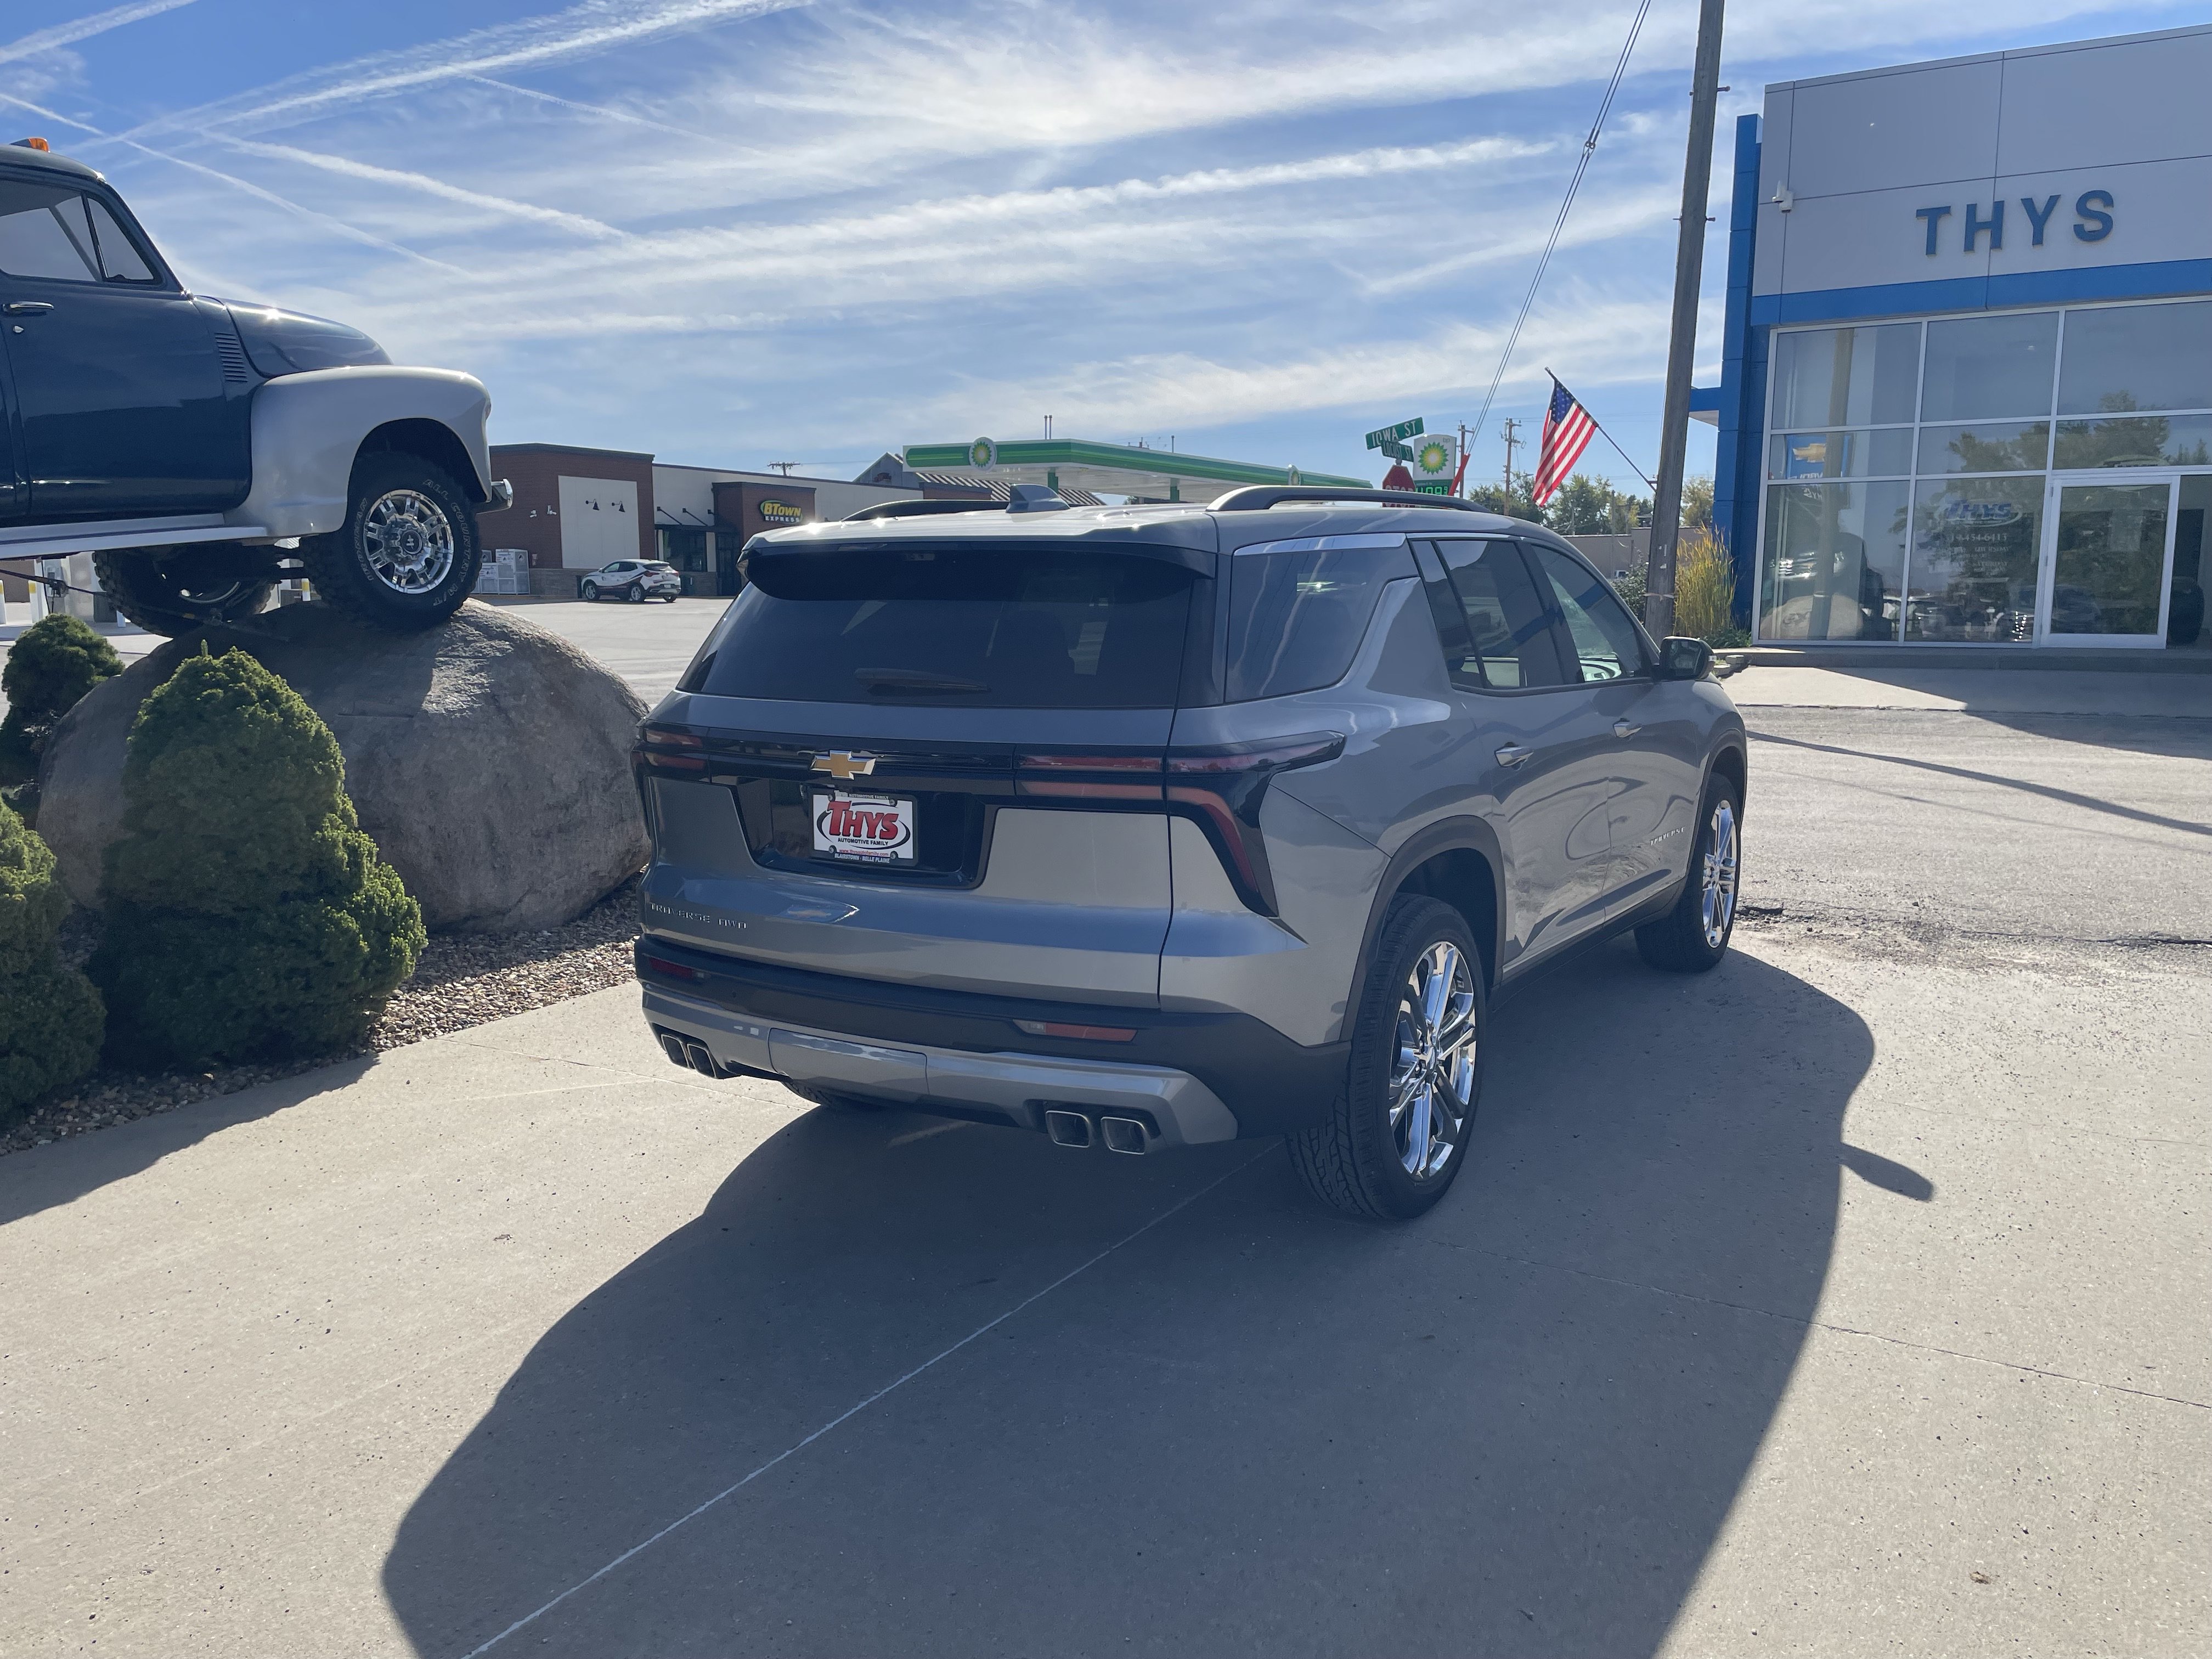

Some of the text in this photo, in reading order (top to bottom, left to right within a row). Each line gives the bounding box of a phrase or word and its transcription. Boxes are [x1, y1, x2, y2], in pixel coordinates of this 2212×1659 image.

[1915, 190, 2114, 256] THYS
[1372, 421, 1416, 446] IOWA ST
[1383, 442, 1412, 462] LOCUST ST
[1947, 500, 2012, 519] THYS
[423, 479, 471, 606] ALL COUNTRY M/T
[827, 801, 899, 840] THYS
